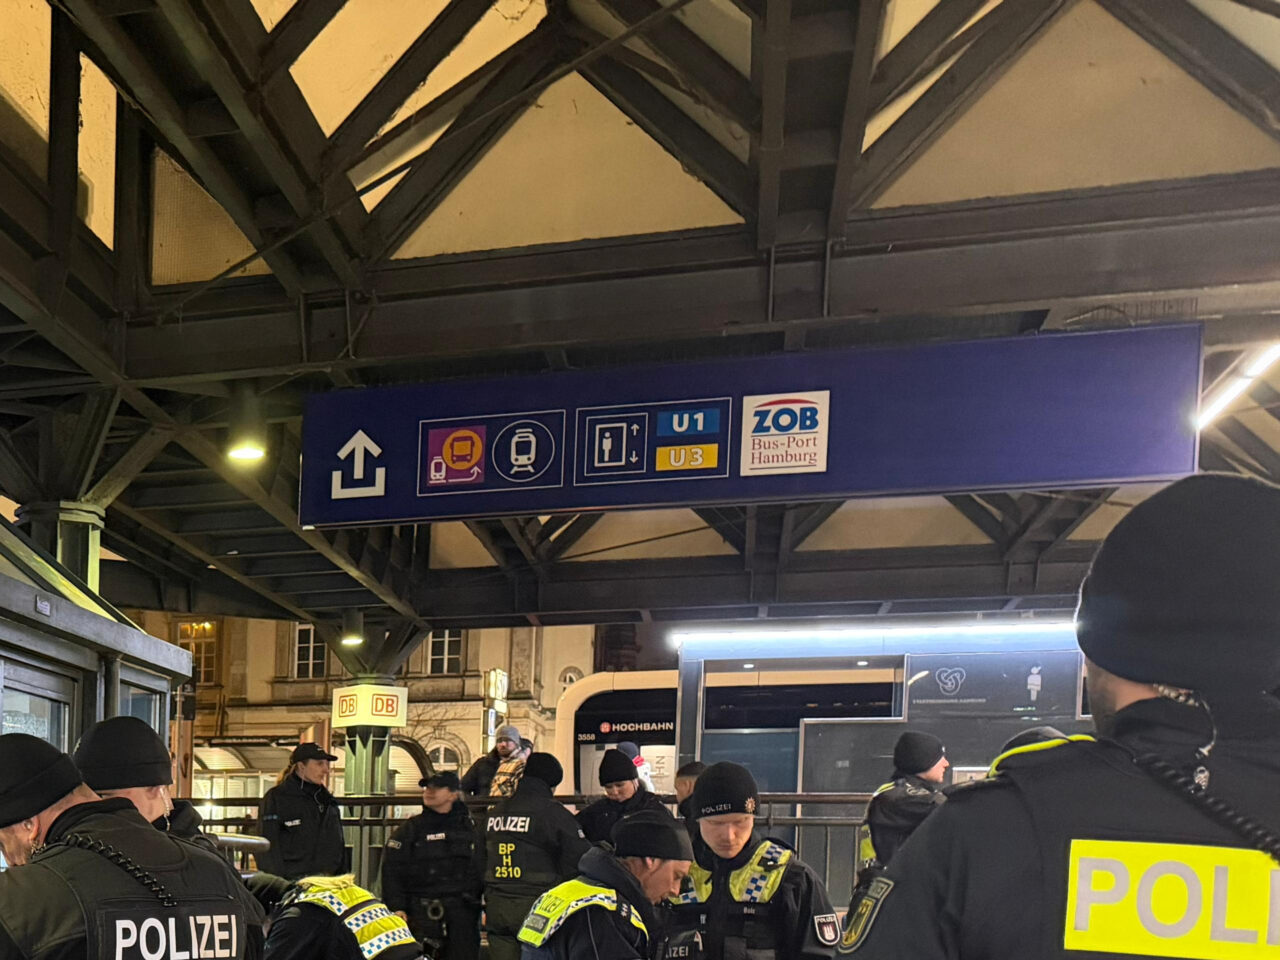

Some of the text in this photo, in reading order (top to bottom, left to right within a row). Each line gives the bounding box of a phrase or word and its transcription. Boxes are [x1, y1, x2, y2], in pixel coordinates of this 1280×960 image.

[672, 412, 705, 433] U1
[751, 407, 819, 434] ZOB
[751, 436, 818, 451] Bus-Port
[751, 450, 818, 466] Hamburg
[341, 695, 356, 715] DB
[374, 697, 396, 714] DB
[612, 722, 674, 732] HOCHBAHN
[578, 733, 596, 741] 3558
[487, 816, 531, 833] POLIZEI
[498, 843, 516, 855] BP
[502, 855, 512, 867] H
[495, 866, 522, 878] 2510
